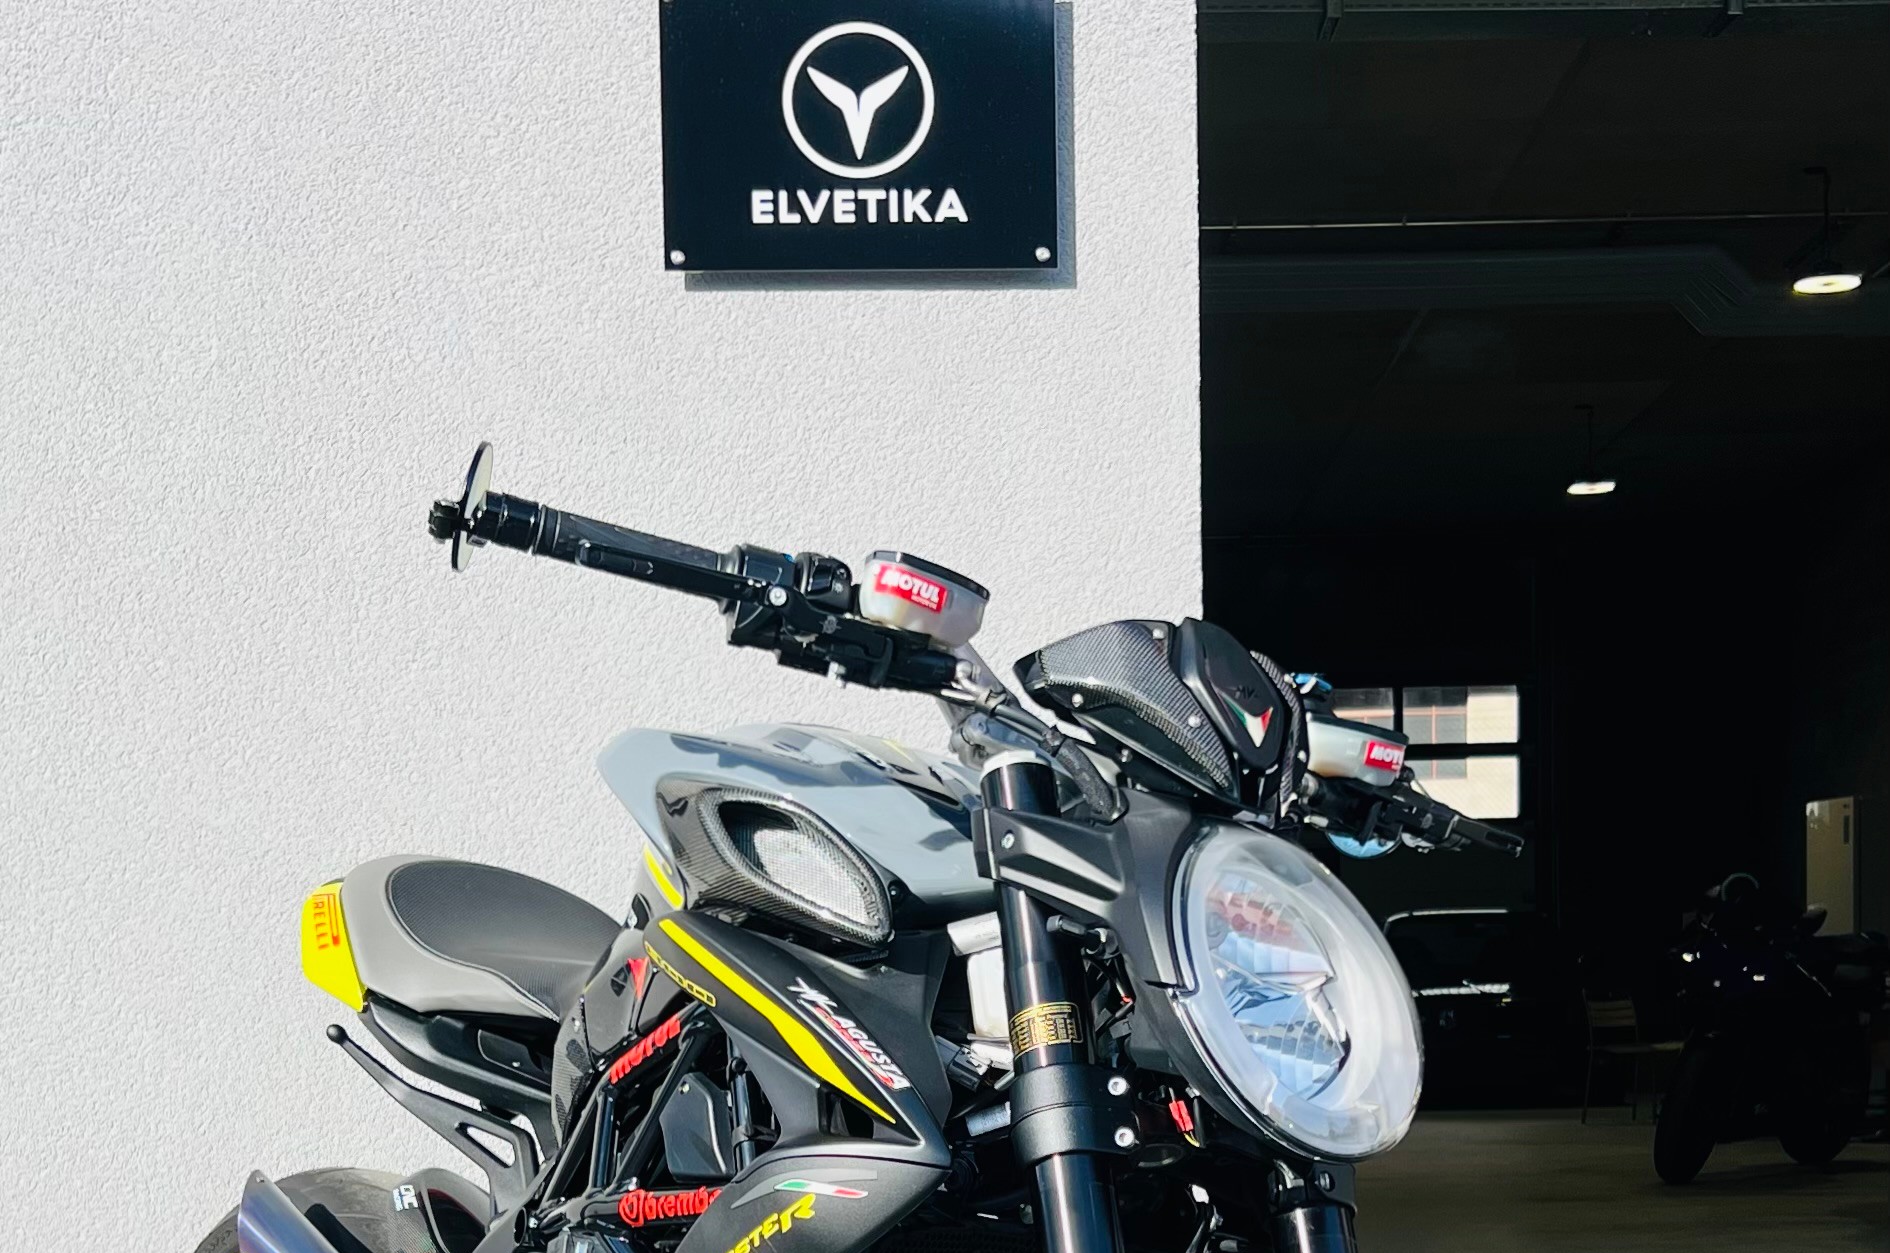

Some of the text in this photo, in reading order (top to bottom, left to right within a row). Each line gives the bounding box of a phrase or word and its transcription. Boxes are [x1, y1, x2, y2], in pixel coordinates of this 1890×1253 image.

[750, 187, 969, 225] ELVETIKA
[880, 568, 941, 604] MOTUL
[831, 1014, 912, 1090] AGUSTA
